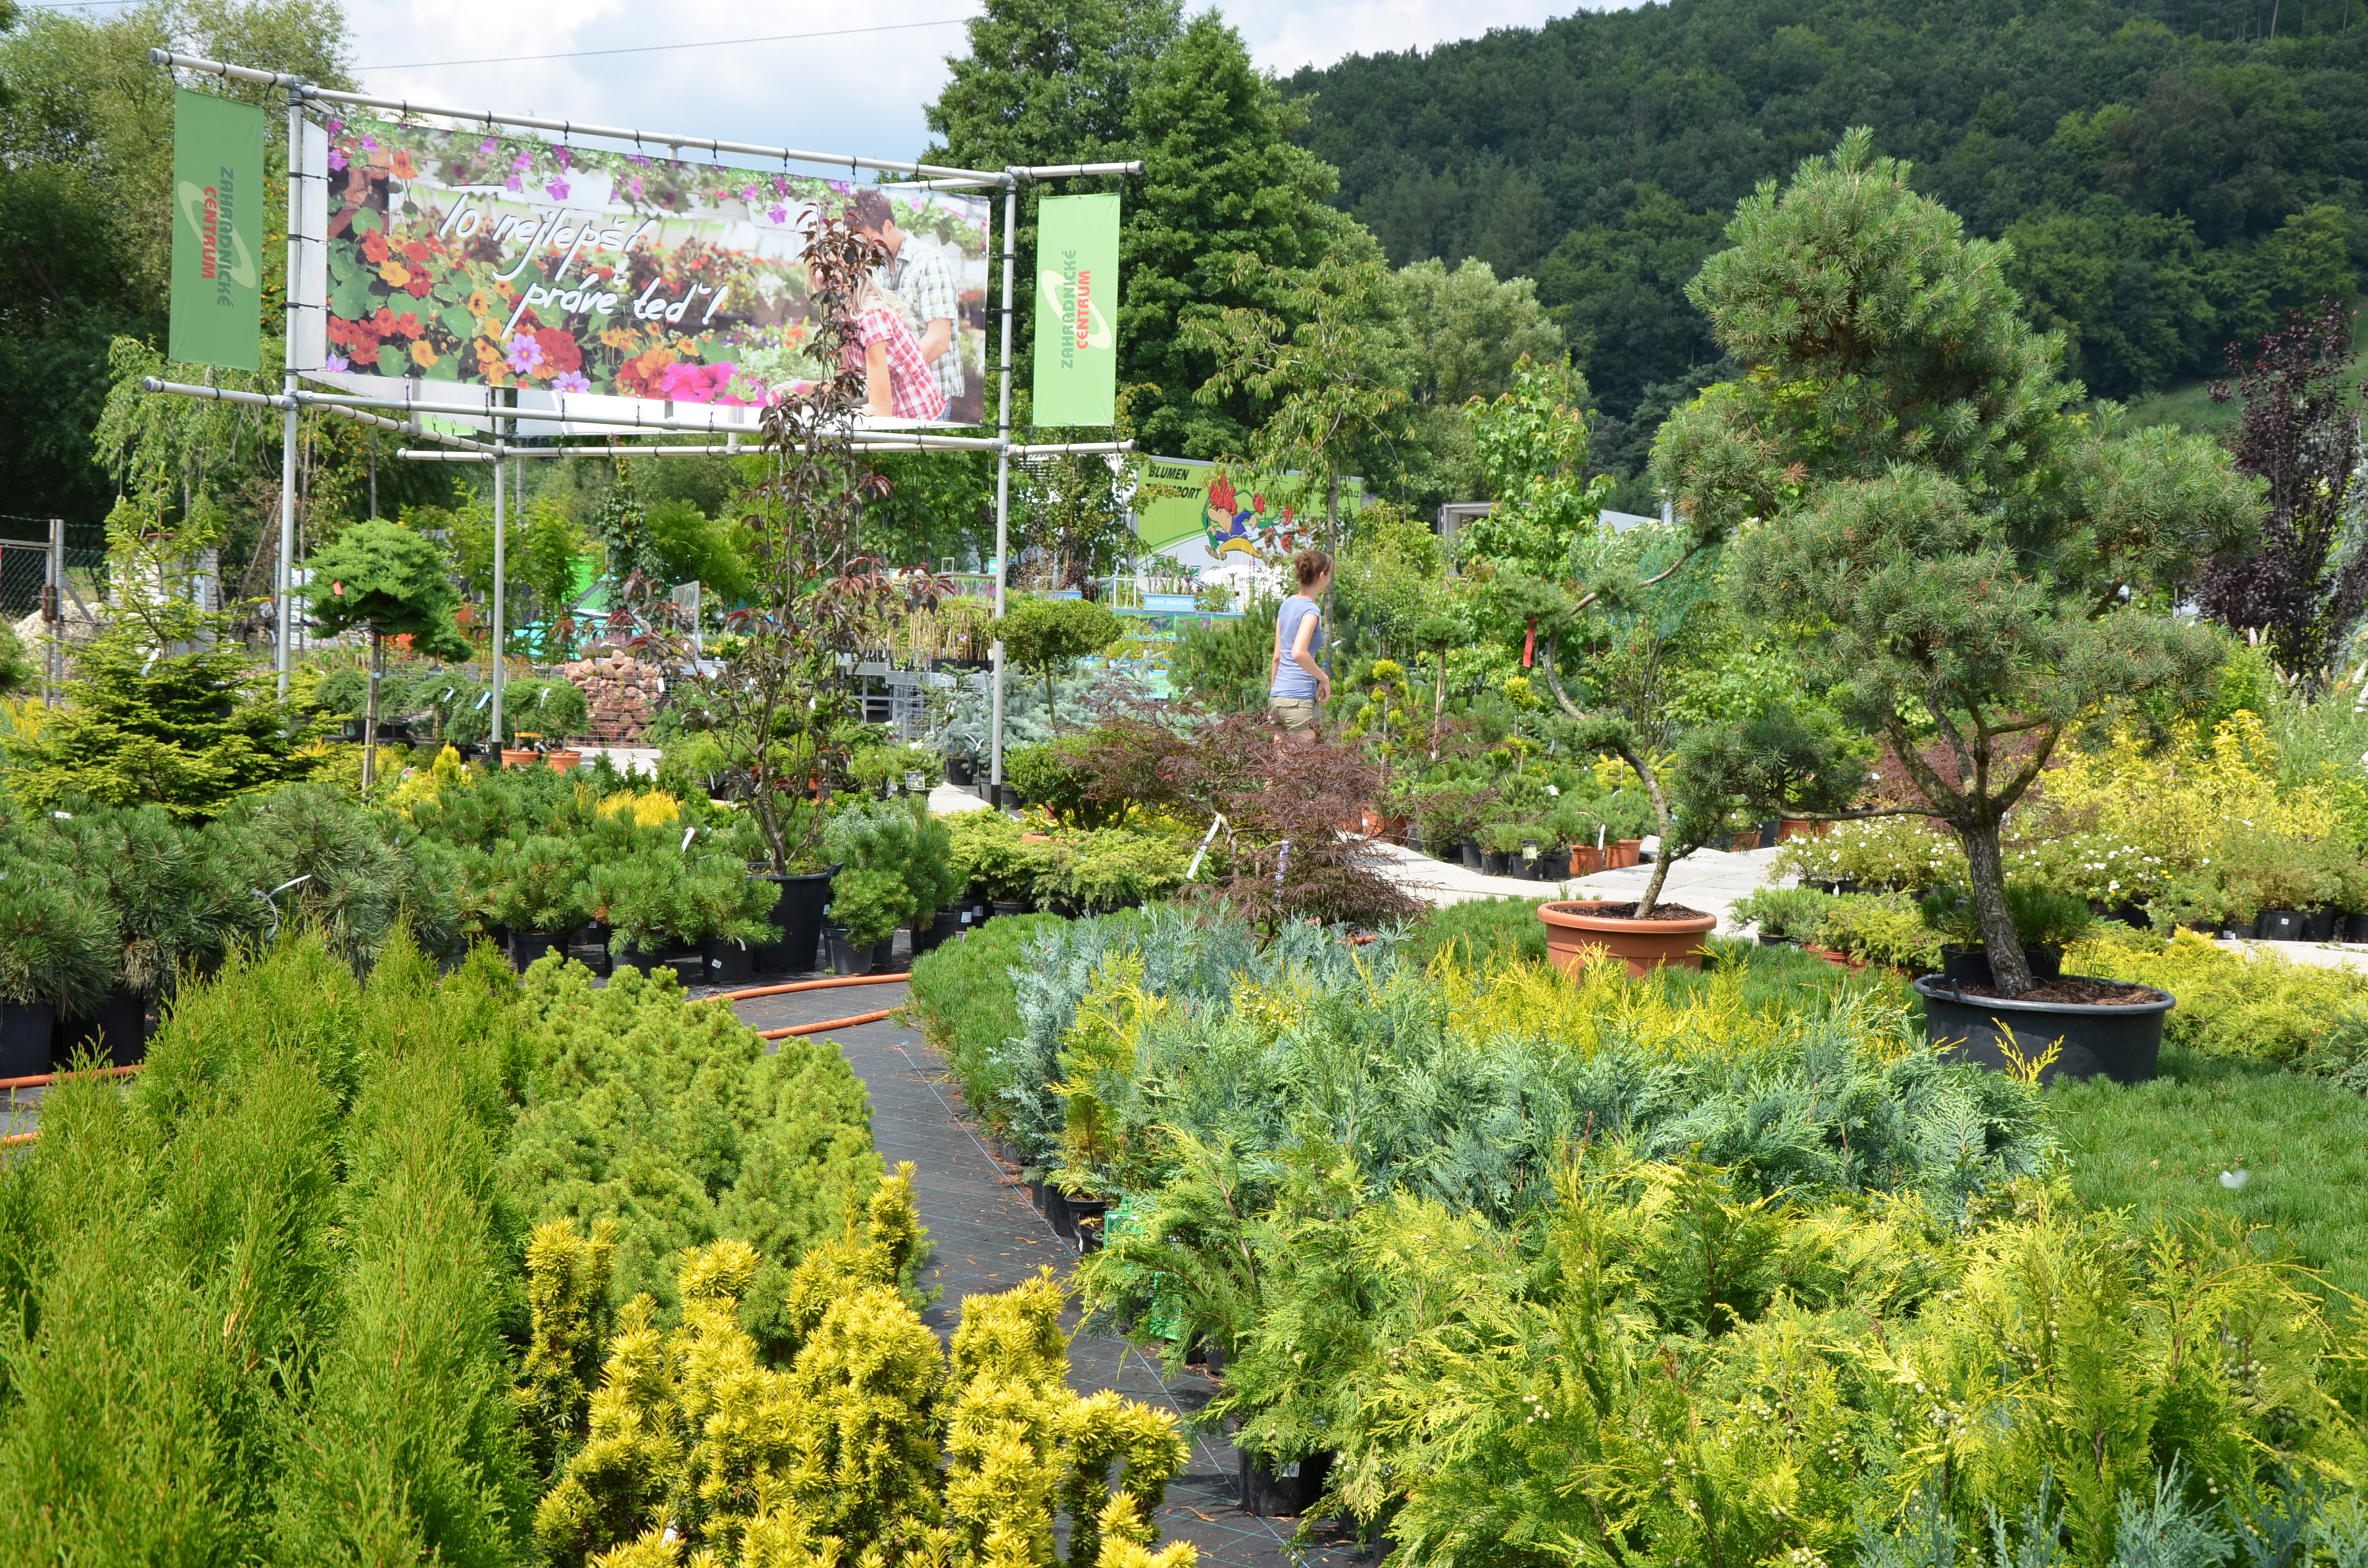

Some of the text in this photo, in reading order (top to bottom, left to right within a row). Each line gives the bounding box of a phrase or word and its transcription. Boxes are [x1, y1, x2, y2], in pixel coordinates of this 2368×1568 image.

[201, 186, 217, 279] CENTRUM
[217, 165, 234, 308] ZAHRADNICKÉ
[438, 184, 657, 282] To nejlepší
[501, 273, 627, 340] právě
[1060, 249, 1077, 370] ZAHRADNICKÉ
[1076, 270, 1091, 350] CENTRUM
[1148, 466, 1190, 481] BLUMEN
